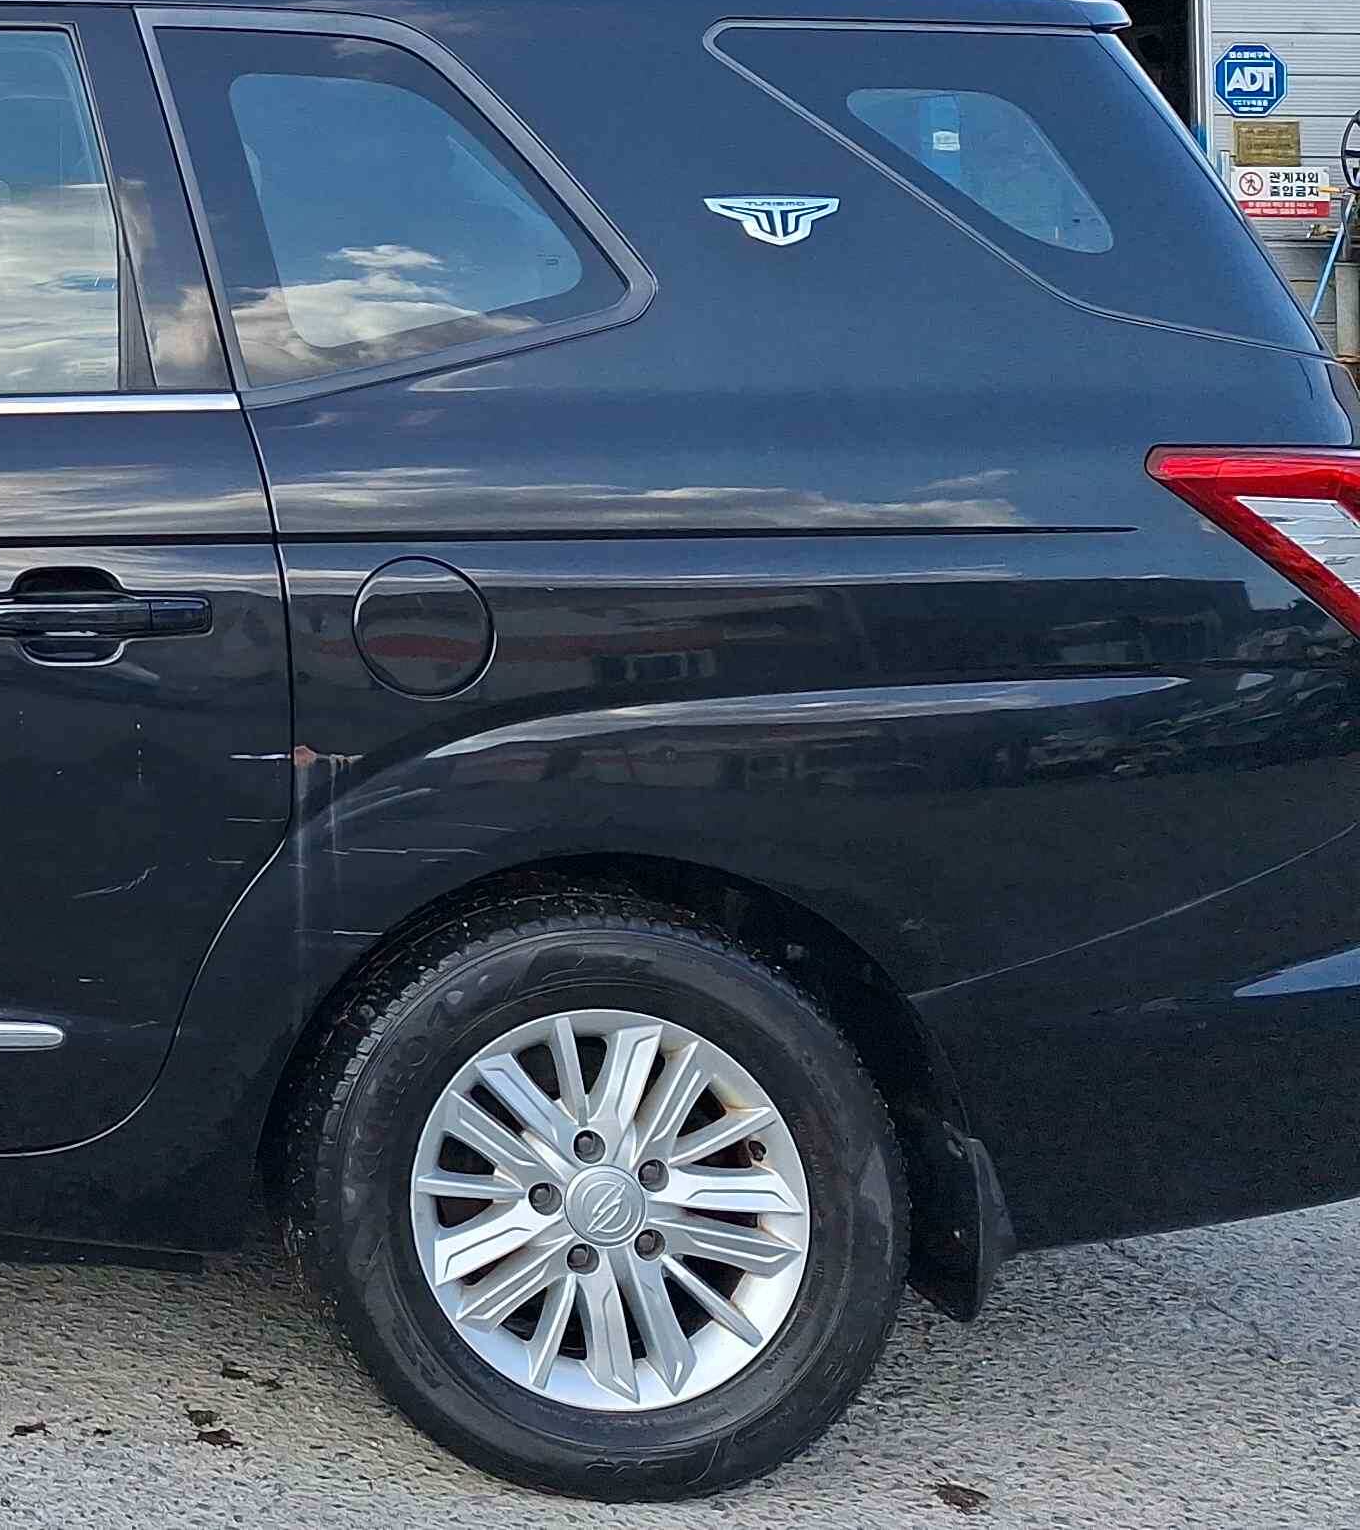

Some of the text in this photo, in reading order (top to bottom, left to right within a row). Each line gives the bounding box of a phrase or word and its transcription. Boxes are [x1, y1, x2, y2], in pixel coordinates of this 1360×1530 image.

[1226, 66, 1273, 92] ADT
[1269, 172, 1319, 184] 관계자외
[1269, 185, 1319, 197] 출입금지
